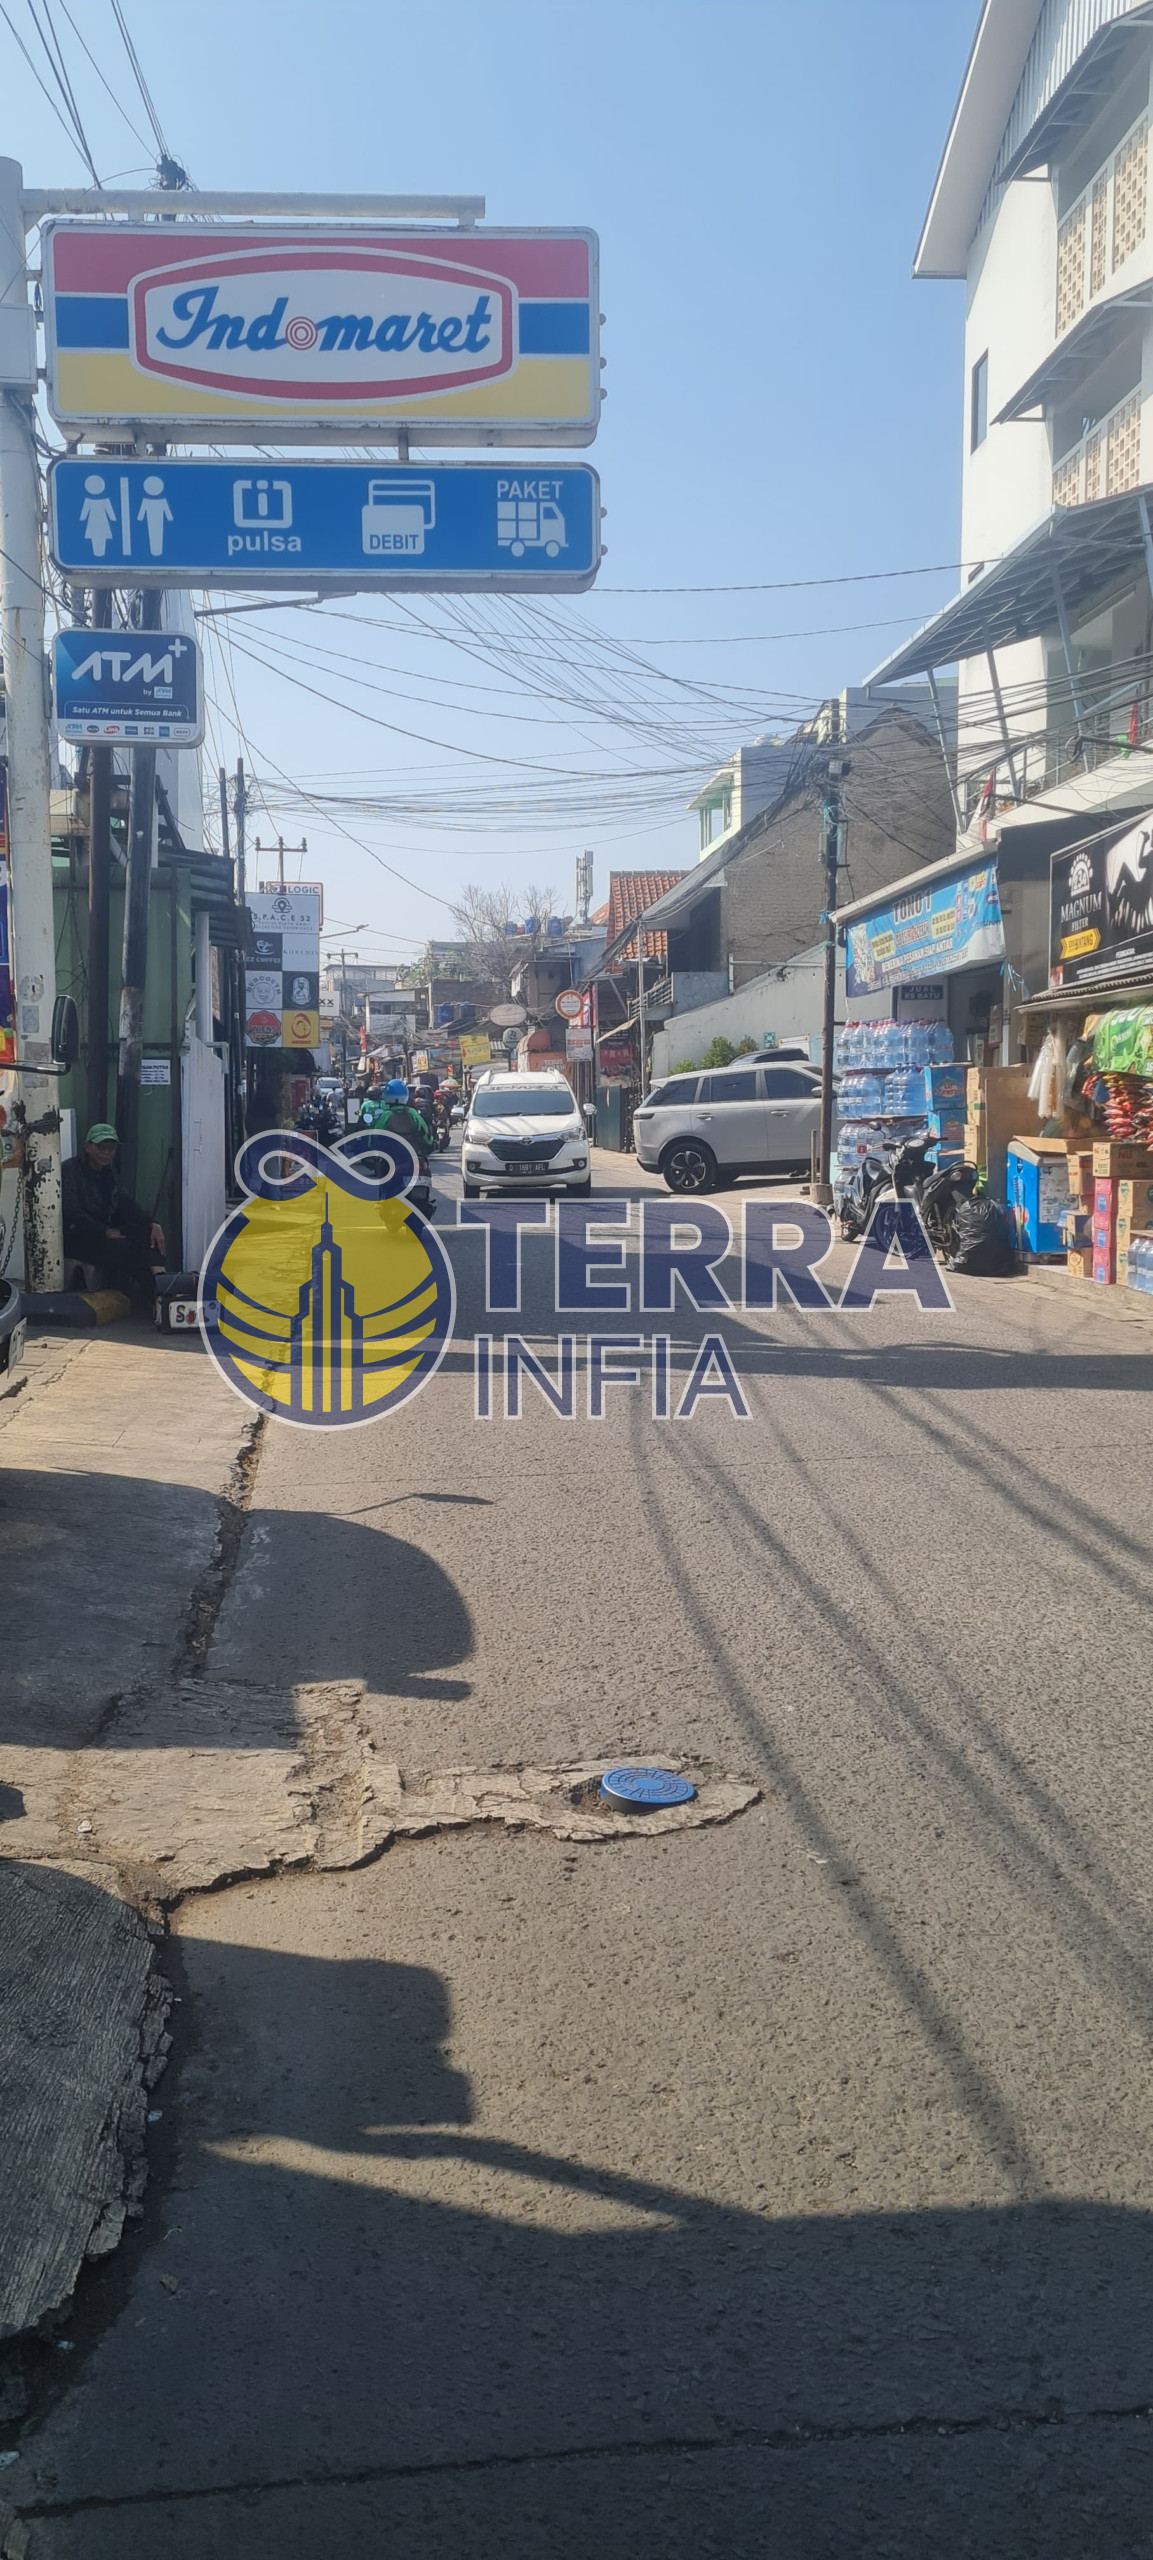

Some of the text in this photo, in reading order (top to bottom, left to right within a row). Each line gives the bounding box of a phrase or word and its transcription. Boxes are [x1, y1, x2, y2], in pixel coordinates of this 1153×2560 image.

[156, 286, 492, 353] Indomaret
[496, 481, 563, 499] PAKET
[227, 531, 302, 556] pulsa
[369, 534, 418, 550] DEBIT
[143, 688, 152, 696] by
[893, 892, 923, 924] TONO
[1061, 892, 1102, 923] MAGNUM
[1072, 917, 1089, 932] FILTER
